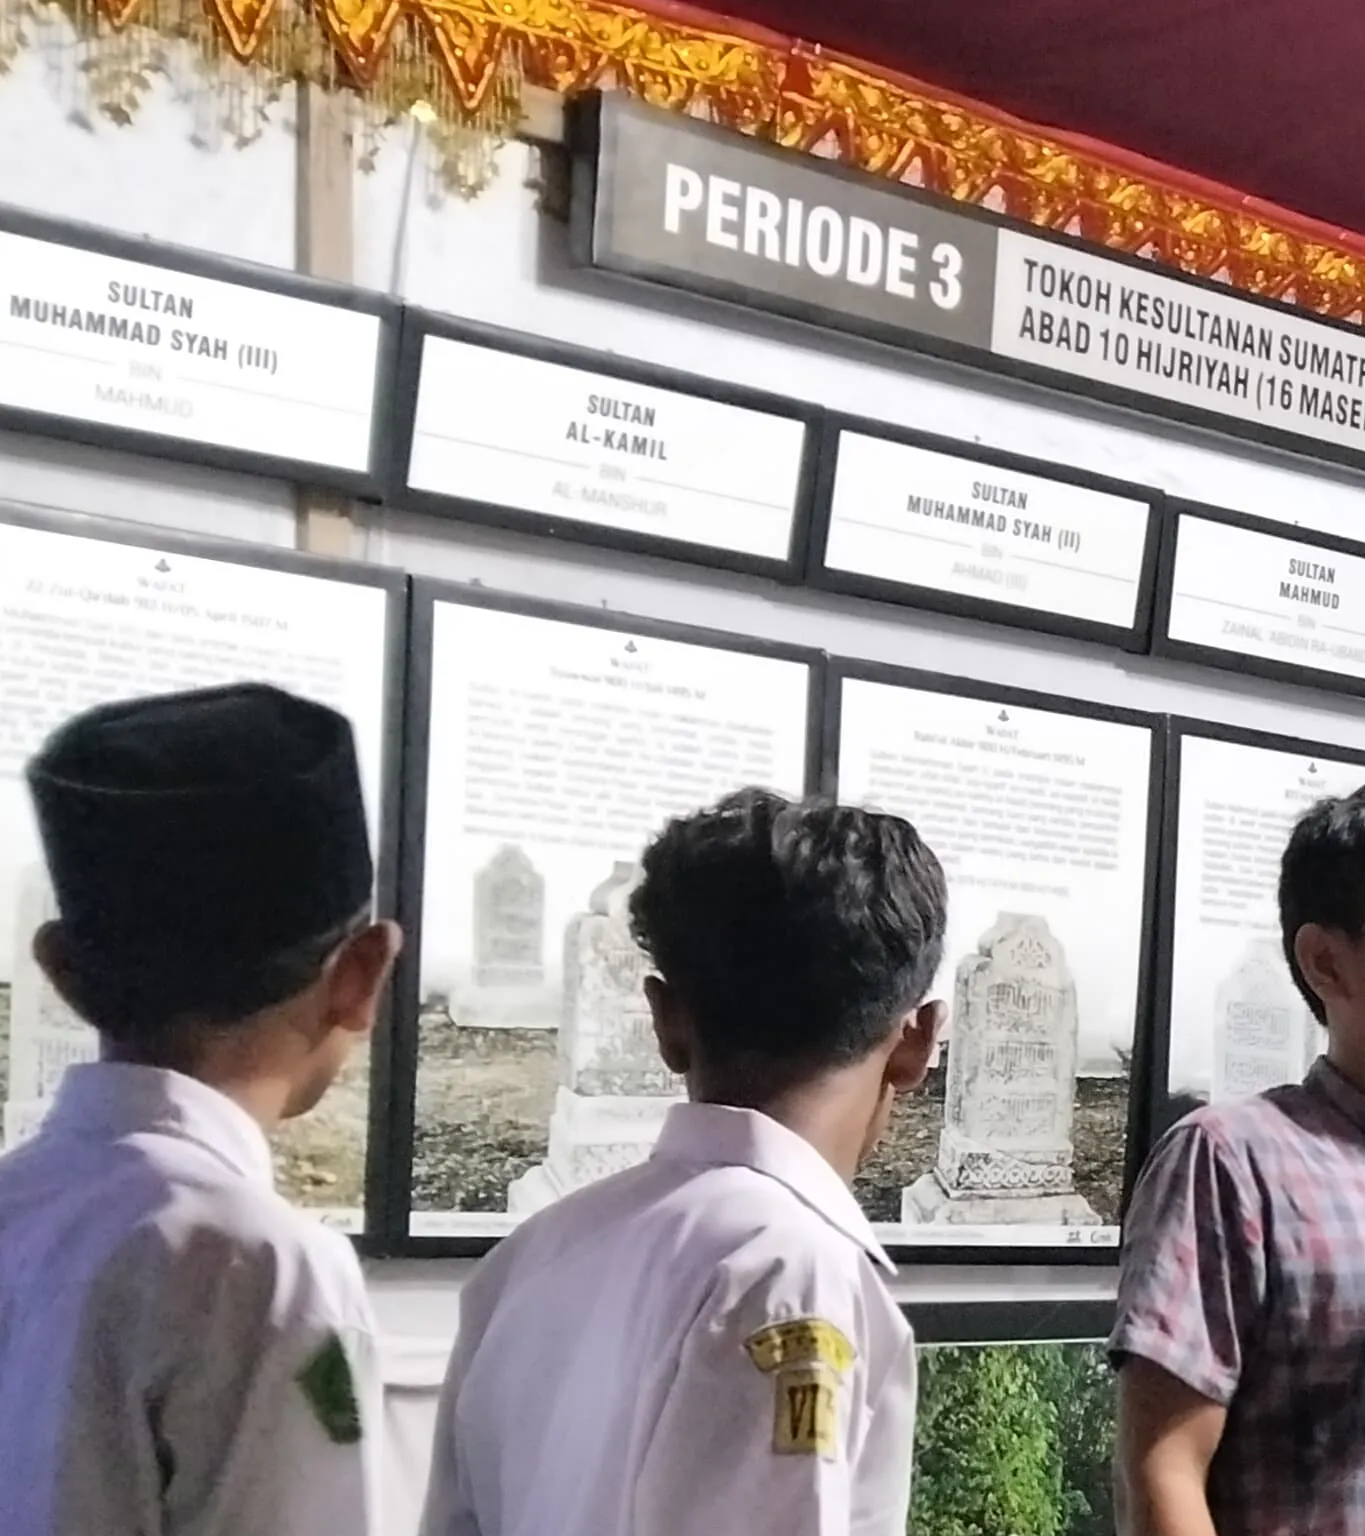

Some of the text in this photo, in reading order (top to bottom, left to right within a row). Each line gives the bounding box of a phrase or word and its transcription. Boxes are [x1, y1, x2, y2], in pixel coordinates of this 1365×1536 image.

[664, 163, 962, 310] PERIODE 3
[108, 281, 193, 318] SULTAN
[1024, 258, 1111, 315] TOKOH
[1120, 286, 1272, 362] KESULTANAN
[10, 295, 278, 375] MUHAMMAD SYAH (III)
[129, 361, 162, 381] BIN
[1020, 306, 1090, 355] ABAD
[1100, 328, 1129, 366] 10
[1137, 338, 1249, 398] HIJRIYAH
[1256, 372, 1293, 411] (16
[96, 383, 194, 418] MAHMUD
[587, 395, 655, 427] SULTAN
[566, 421, 667, 460] AL-KAMIL
[599, 464, 626, 482] BIN
[971, 481, 1028, 510] SULTAN
[907, 494, 1081, 553] MUHAMMAD SYAH (II)
[1288, 558, 1336, 584] SULTAN
[1279, 581, 1340, 610] MAHMUD
